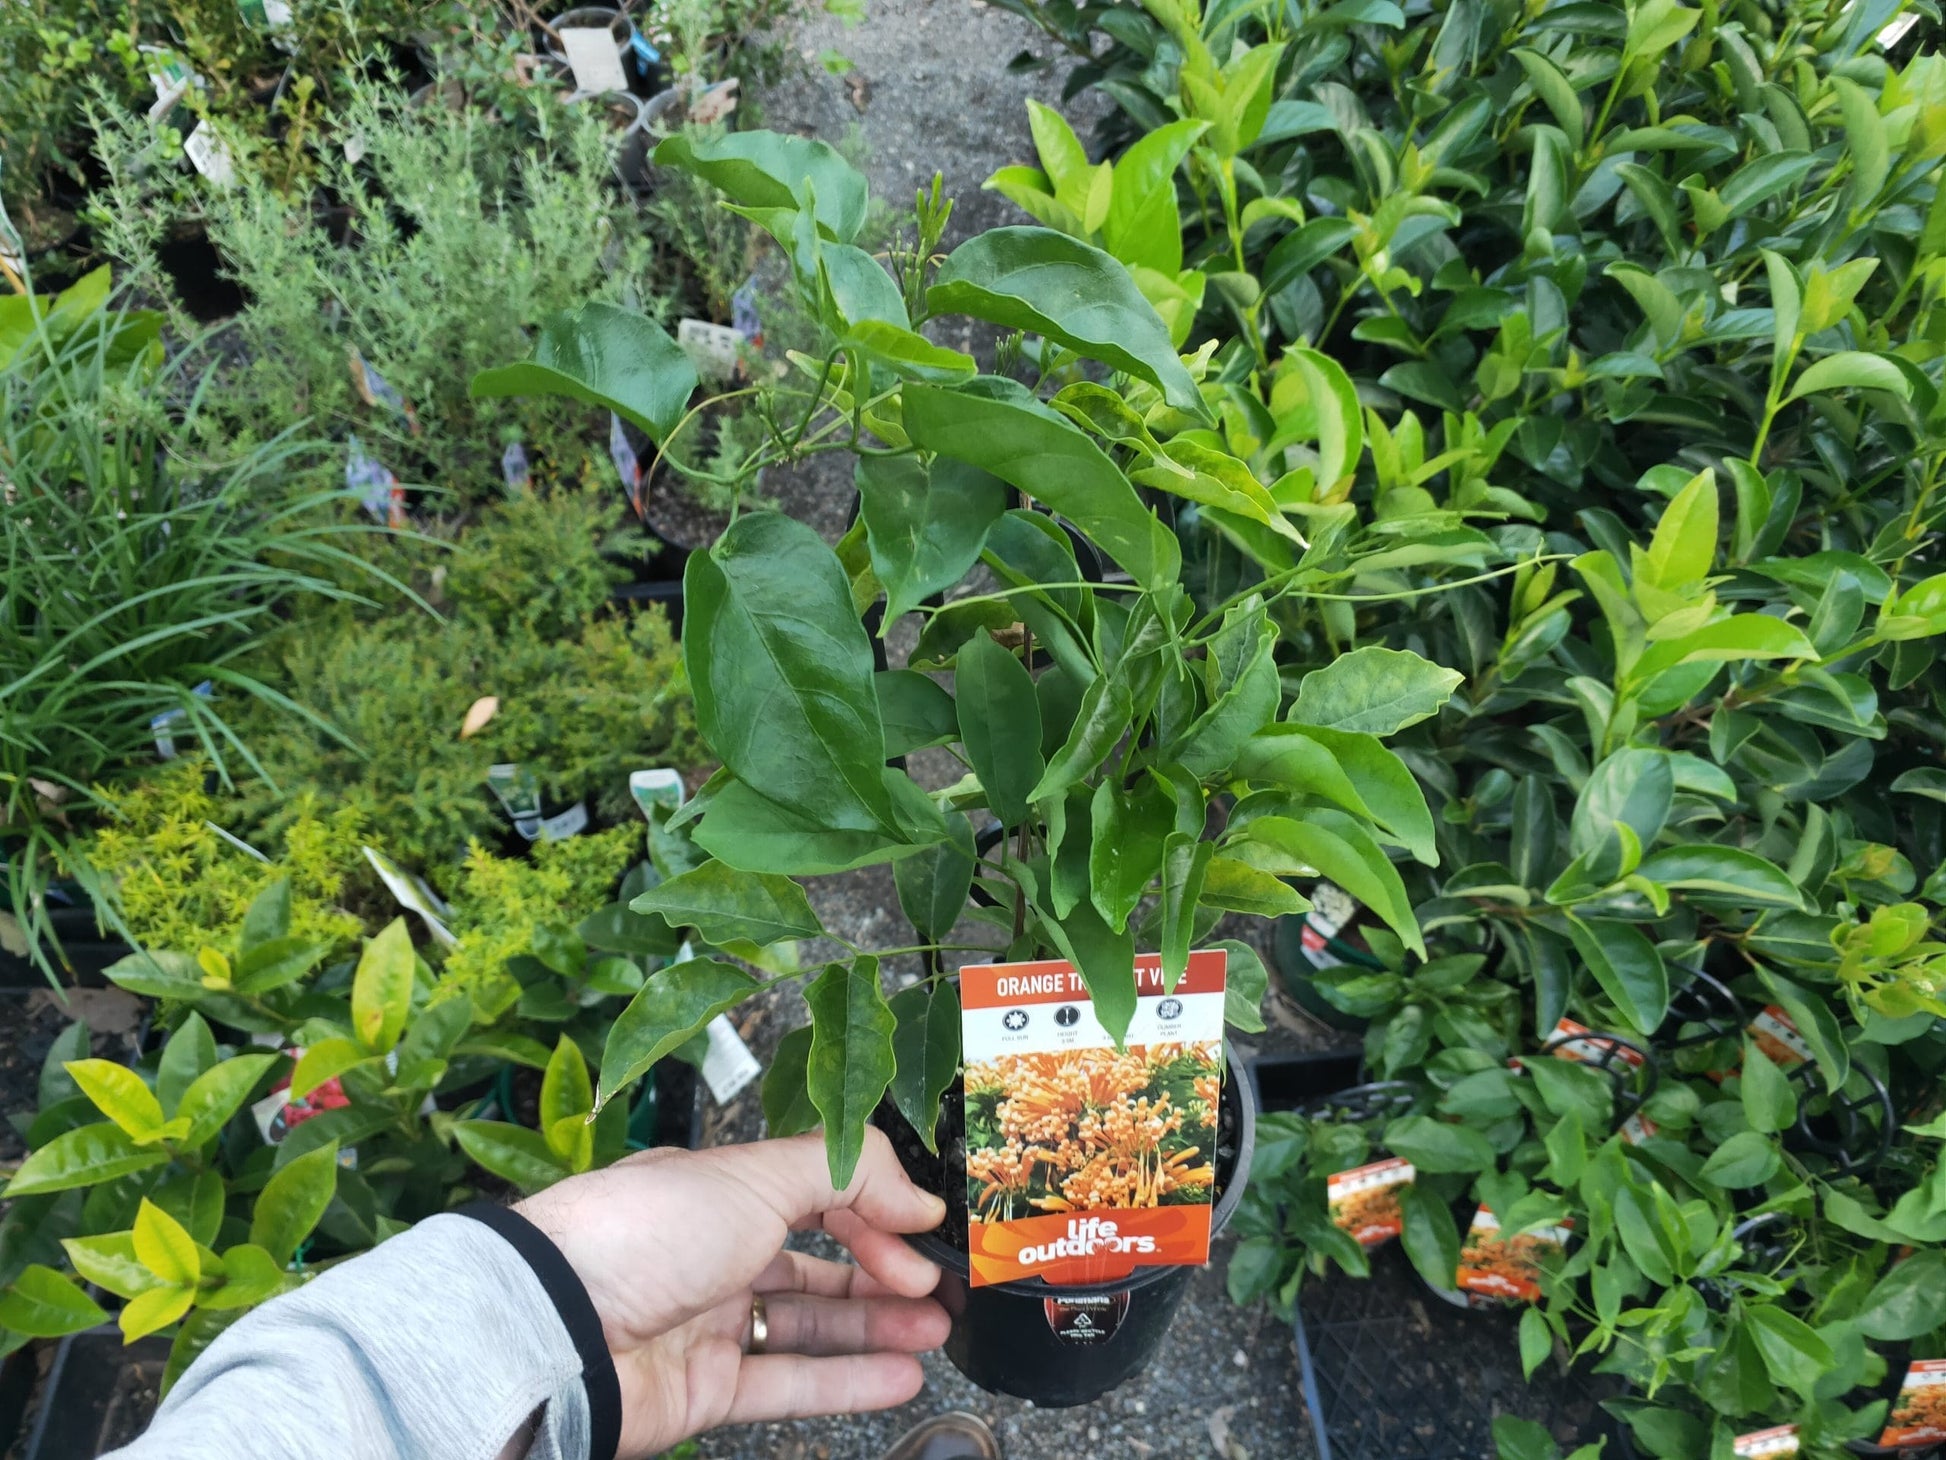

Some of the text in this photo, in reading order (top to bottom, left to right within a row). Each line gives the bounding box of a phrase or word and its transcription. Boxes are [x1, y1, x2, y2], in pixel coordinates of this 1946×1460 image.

[996, 973, 1064, 997] ORANGE
[1149, 966, 1188, 986] VIE
[1018, 1235, 1156, 1265] outdoors
